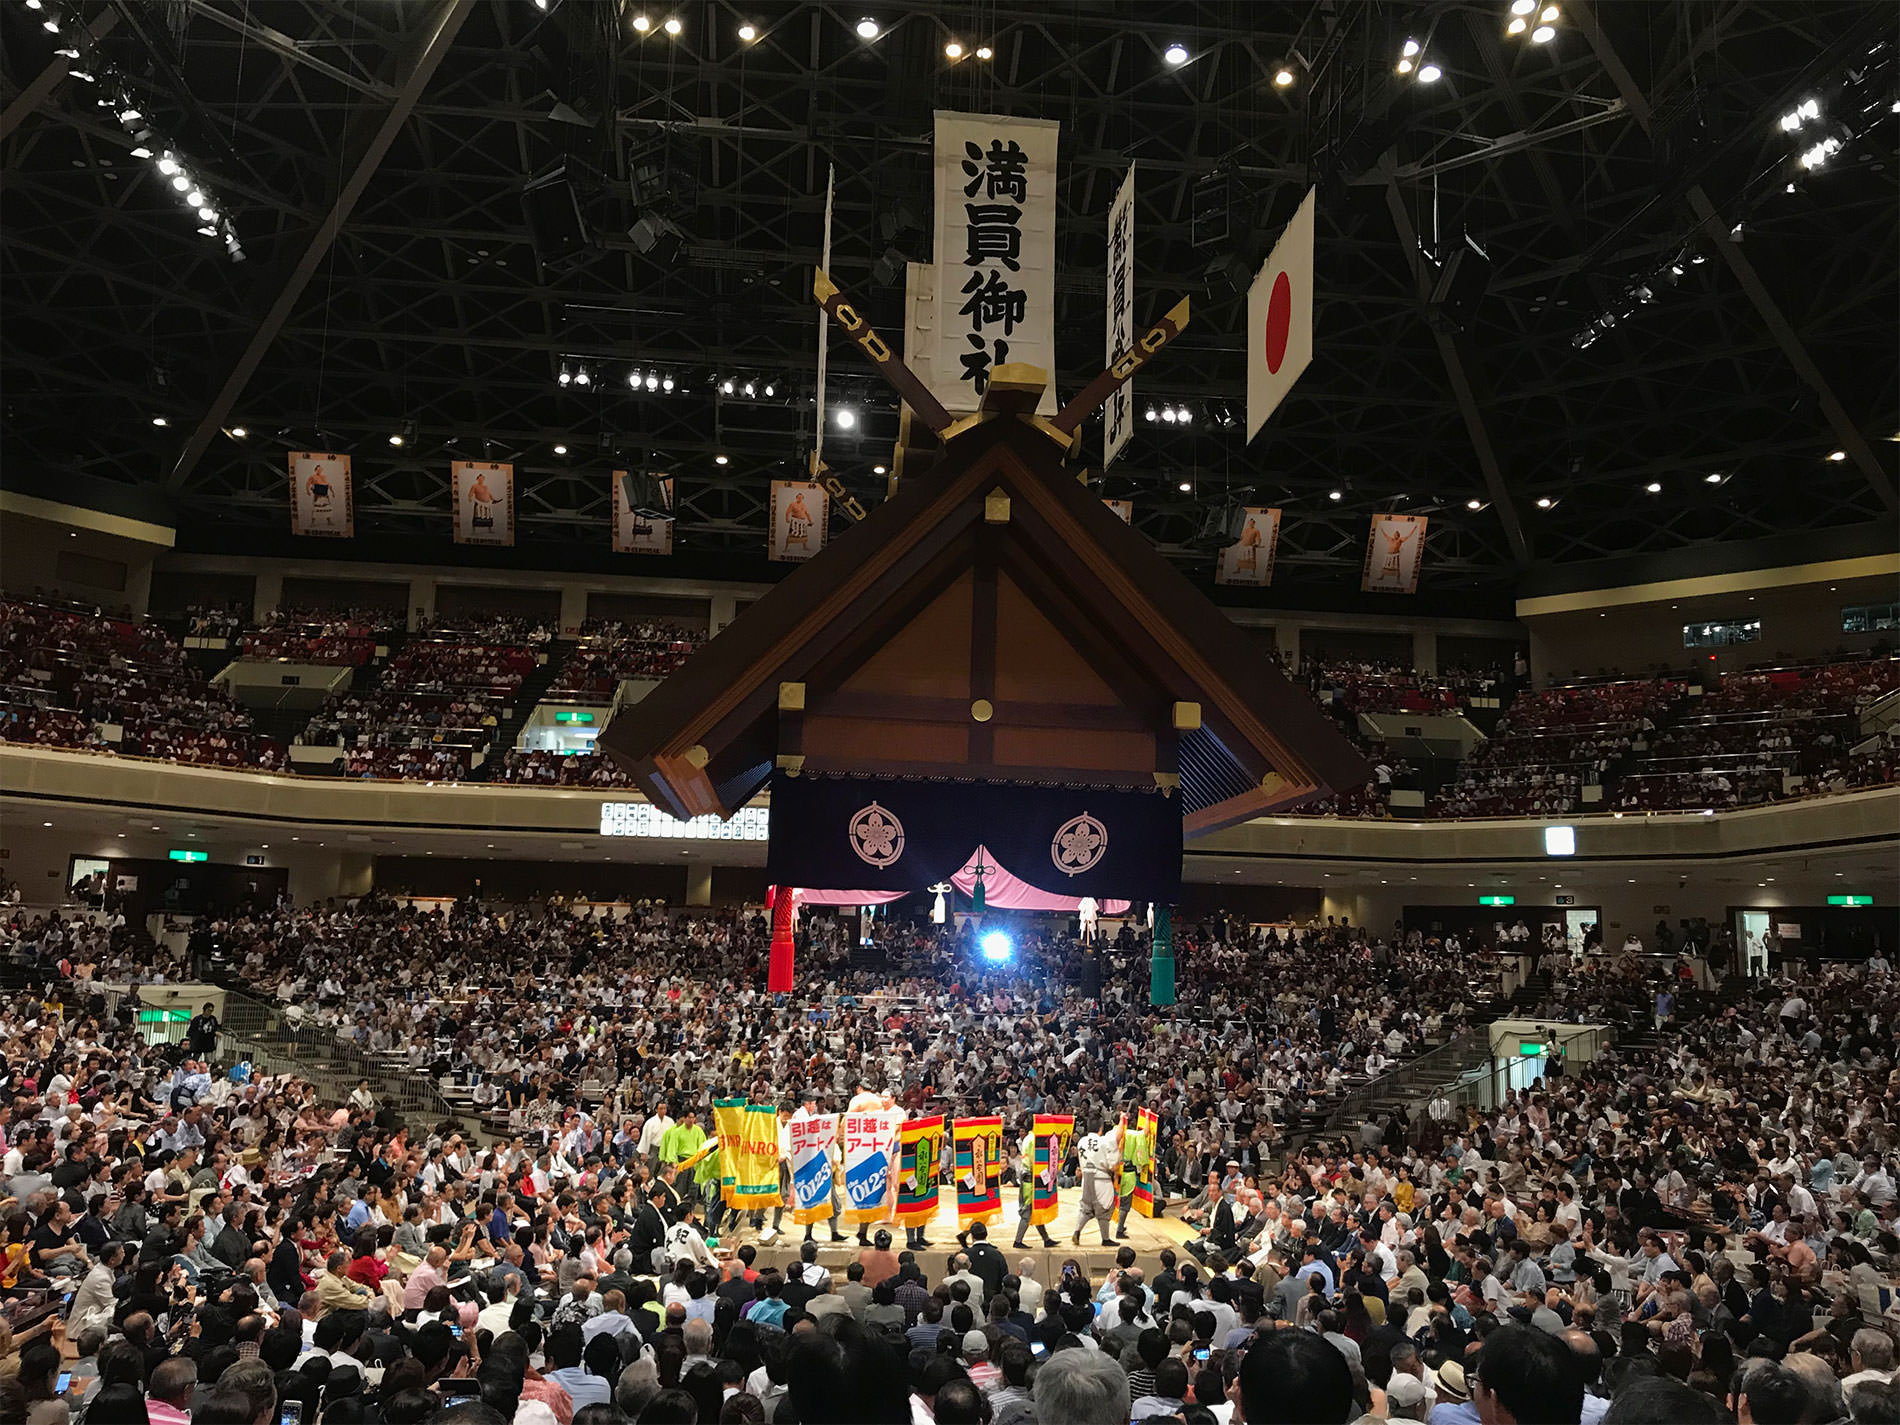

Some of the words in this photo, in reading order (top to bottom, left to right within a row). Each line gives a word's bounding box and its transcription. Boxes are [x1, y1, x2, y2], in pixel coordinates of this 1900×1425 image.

[792, 1119, 832, 1137] 引越は
[847, 1118, 889, 1134] 引越は
[800, 1162, 831, 1202] 0123
